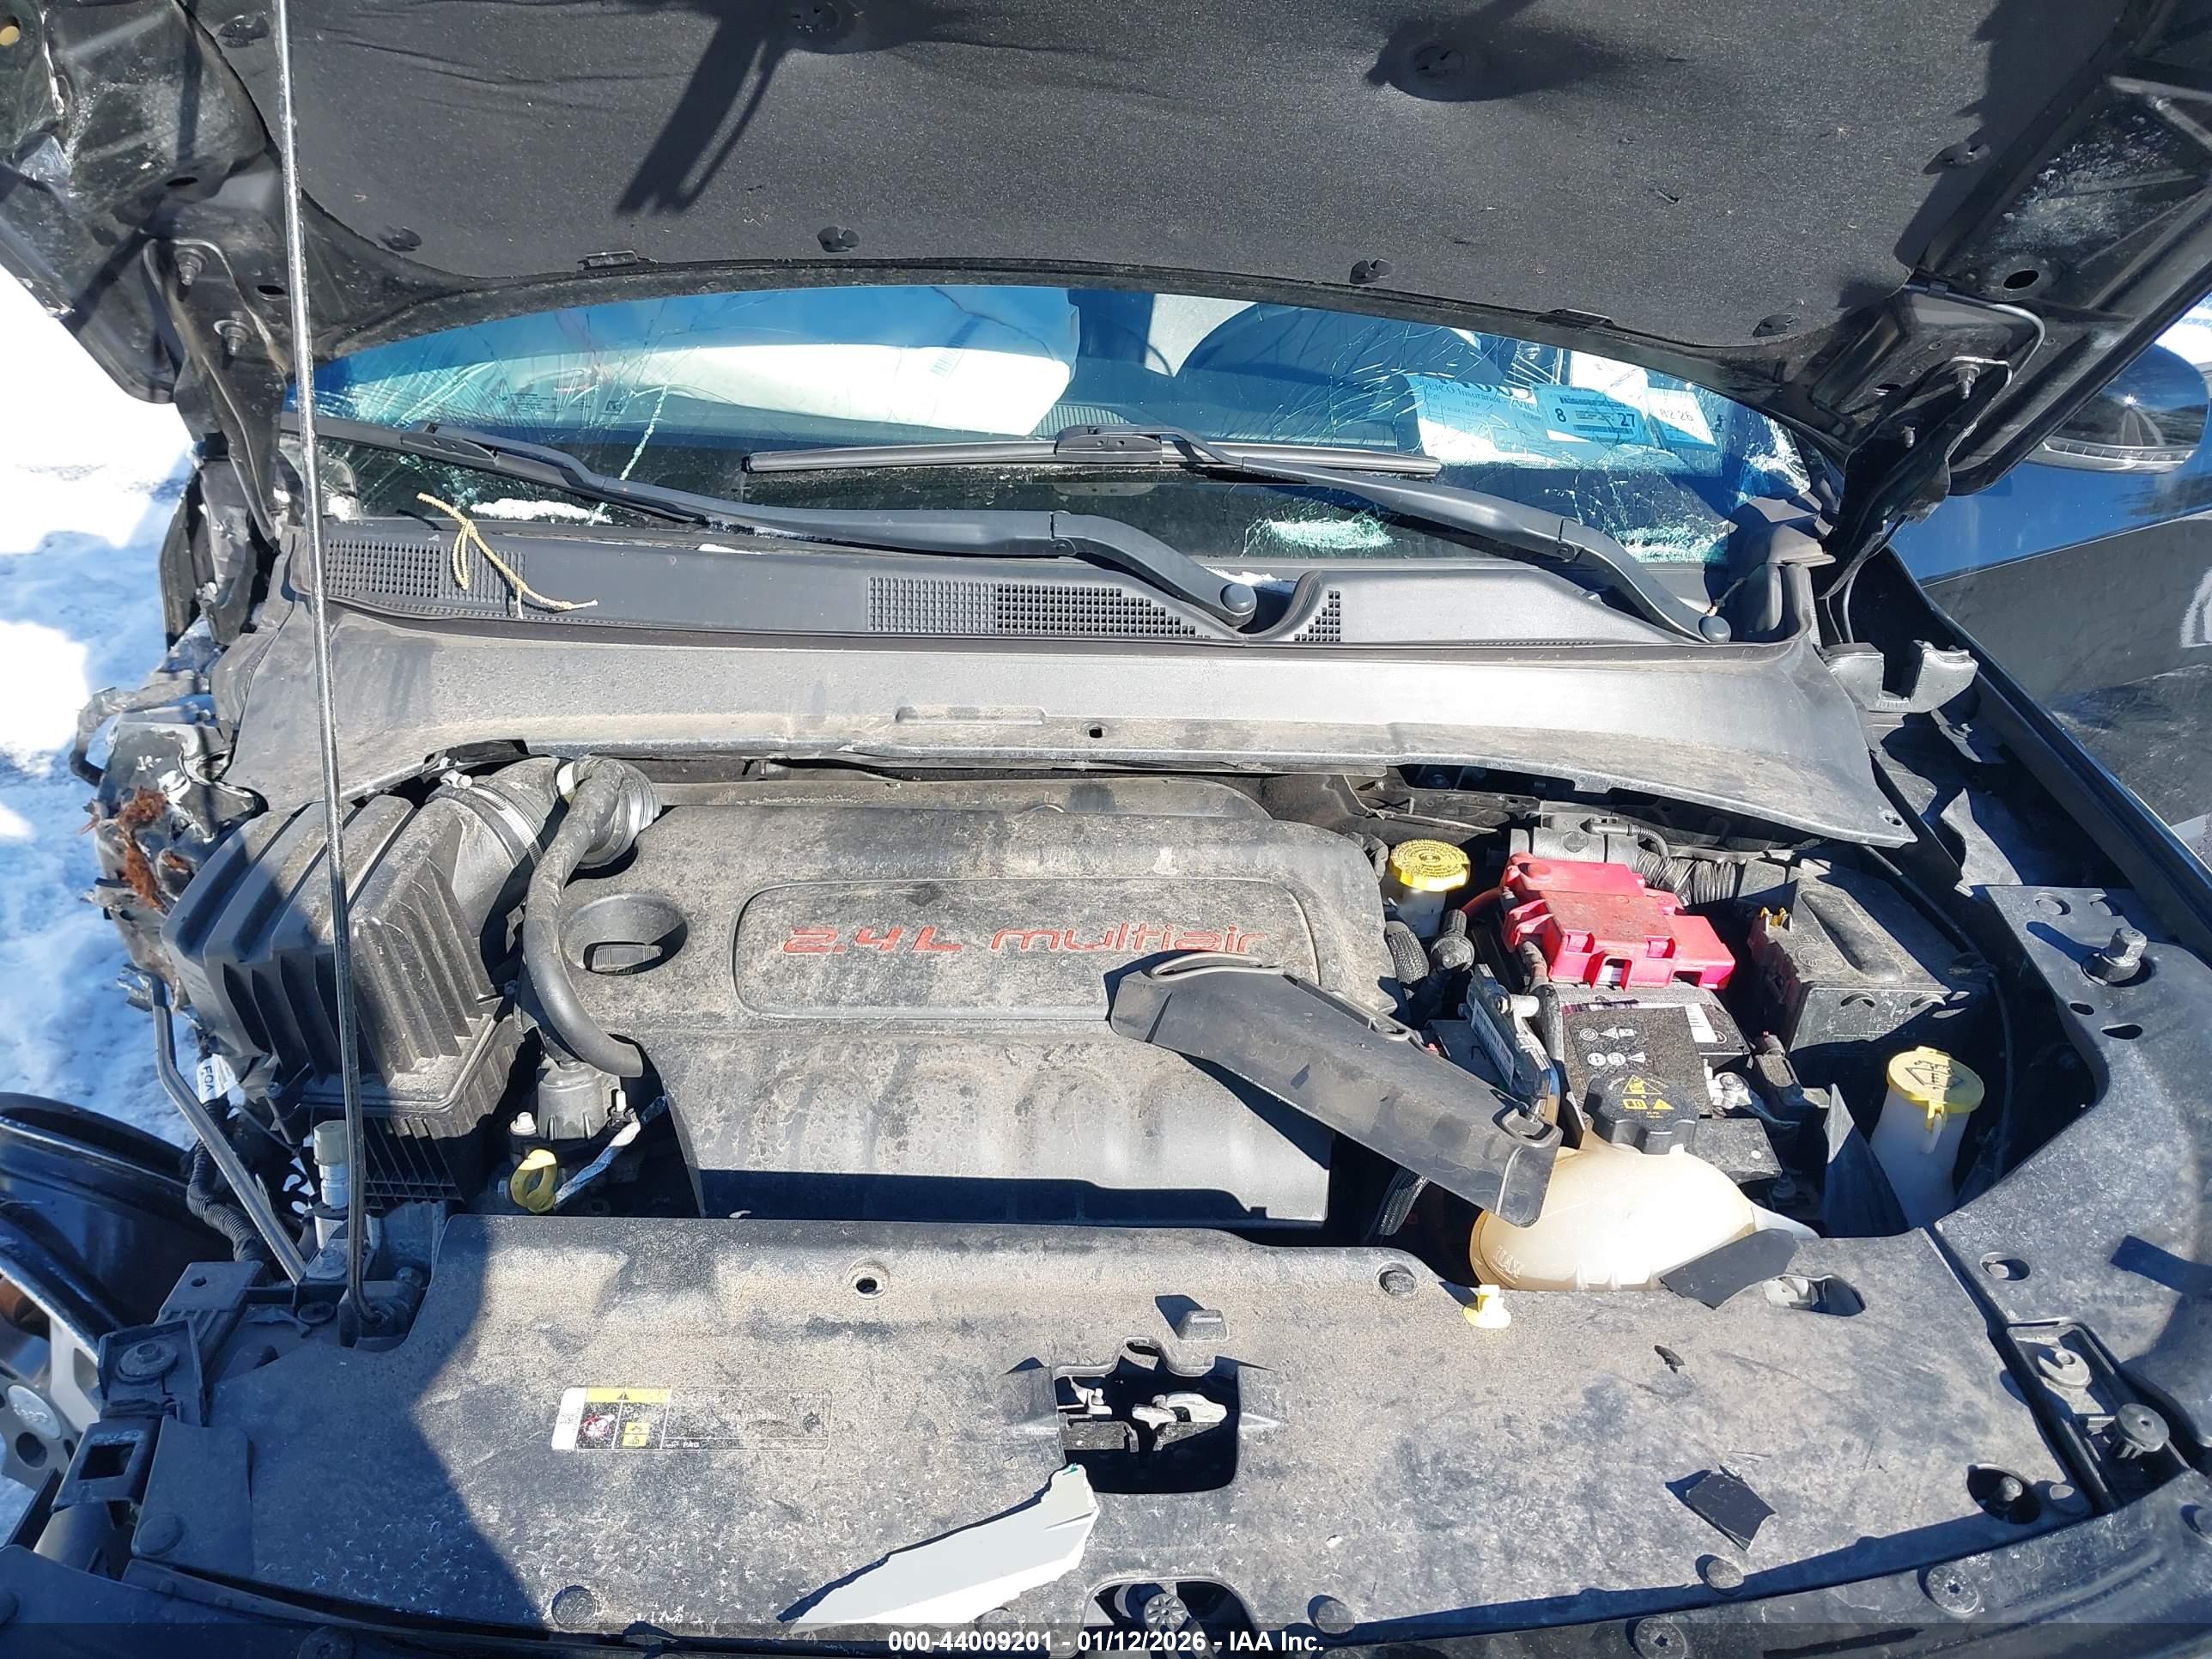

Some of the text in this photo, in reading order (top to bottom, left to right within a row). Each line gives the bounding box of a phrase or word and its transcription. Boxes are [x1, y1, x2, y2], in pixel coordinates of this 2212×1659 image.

[1554, 408, 1567, 422] 8
[1617, 412, 1636, 428] 27
[782, 921, 1268, 955] 2.4L multiair
